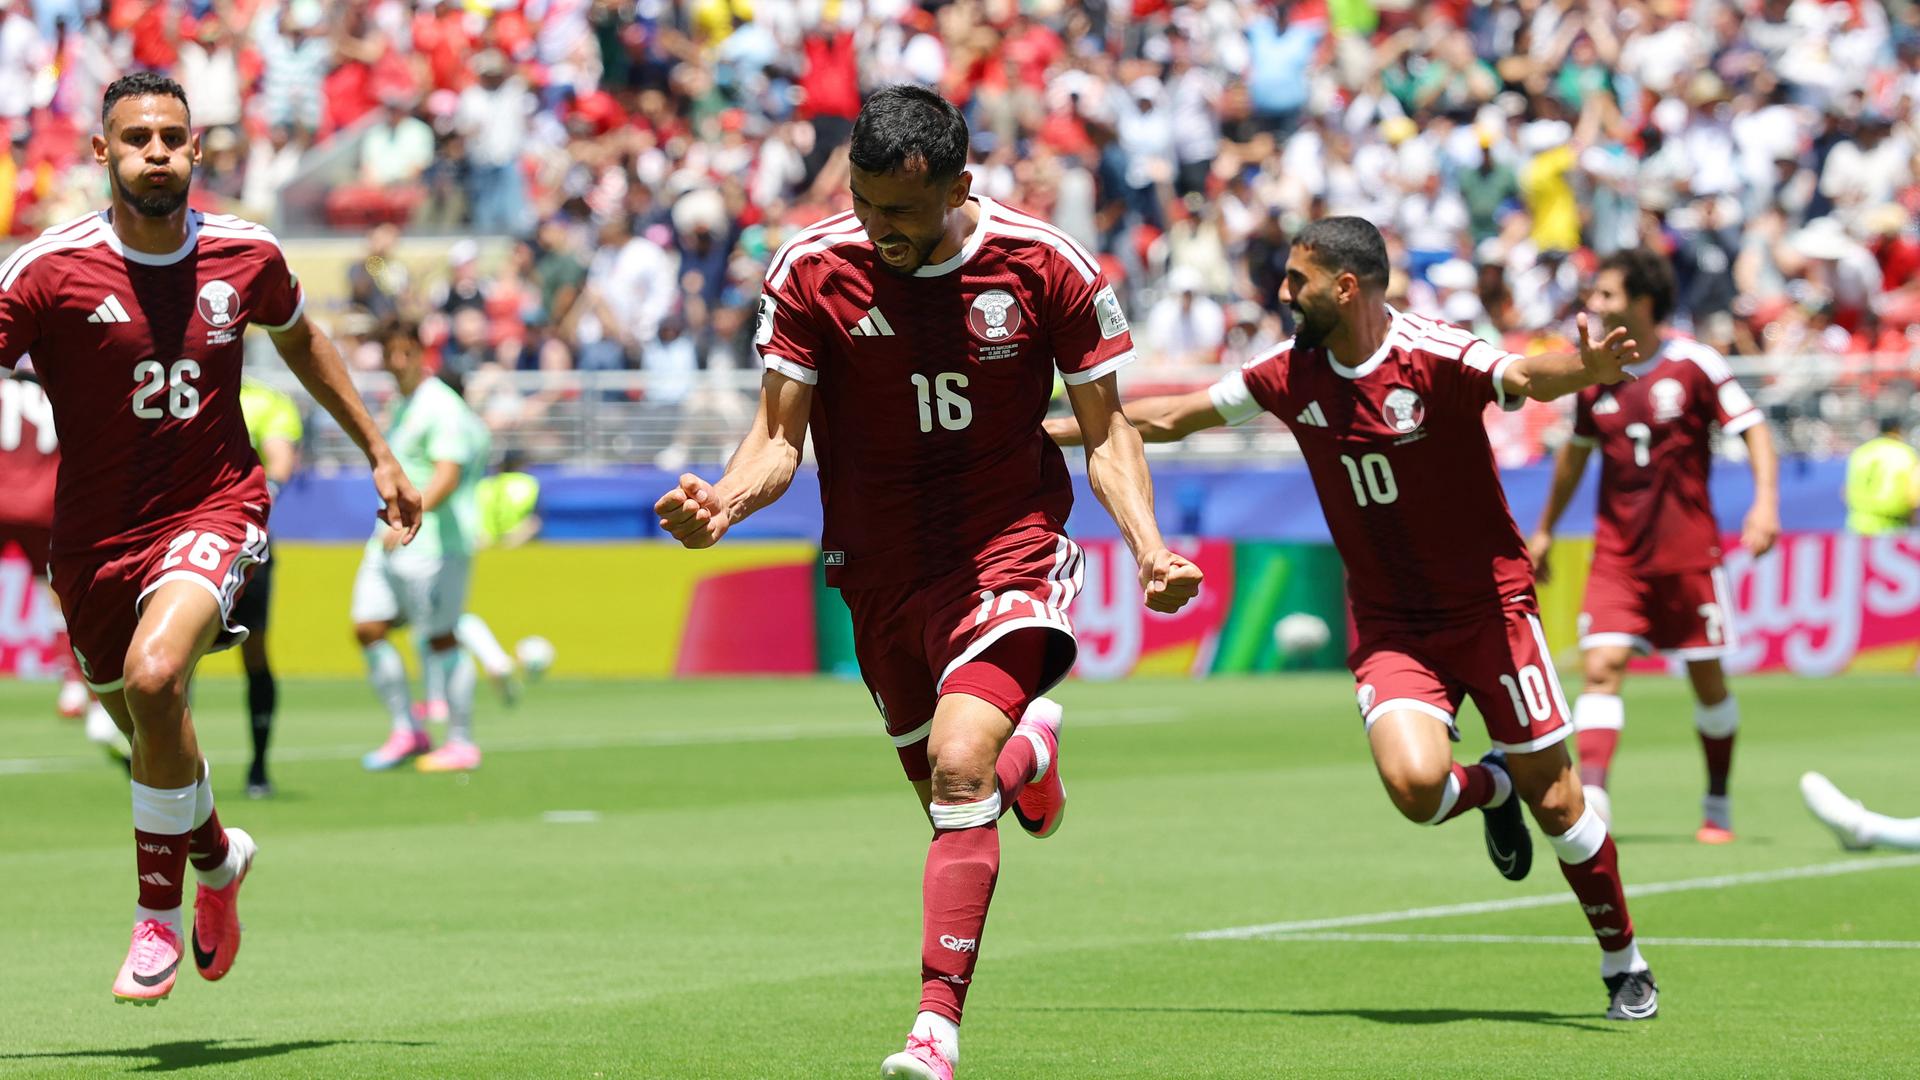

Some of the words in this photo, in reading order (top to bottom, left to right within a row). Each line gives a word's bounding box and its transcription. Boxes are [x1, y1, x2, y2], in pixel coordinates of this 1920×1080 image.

[986, 327, 1009, 338] QFA
[0, 378, 59, 455] 14
[132, 359, 201, 419] 26
[911, 372, 973, 433] 16
[1625, 422, 1651, 467] 7
[1340, 453, 1399, 507] 10
[161, 530, 230, 571] 26
[1690, 532, 1920, 678] ays
[1499, 664, 1552, 727] 10
[940, 934, 976, 952] QFA
